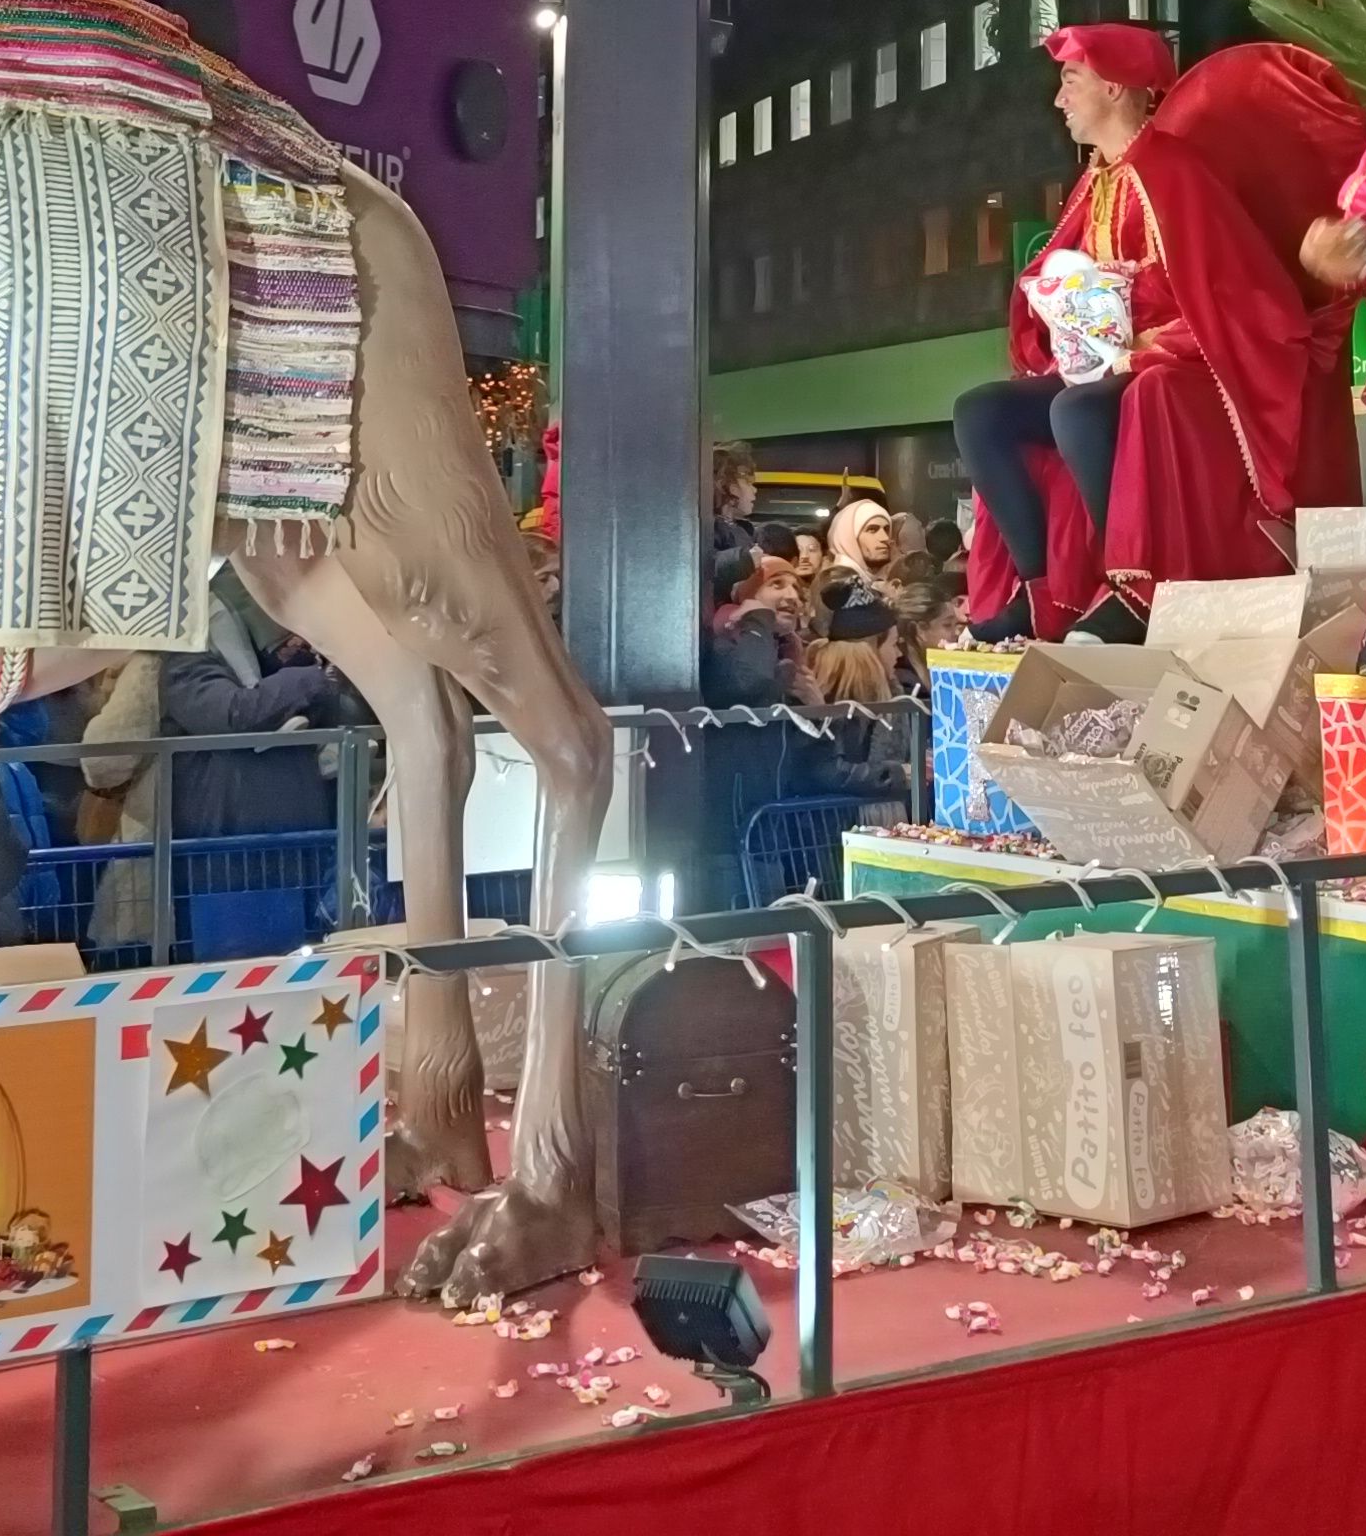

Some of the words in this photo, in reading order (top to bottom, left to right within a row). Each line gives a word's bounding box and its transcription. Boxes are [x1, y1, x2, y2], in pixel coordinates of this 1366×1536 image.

[1067, 974, 1098, 1041] feo
[1070, 1060, 1099, 1192] Patito
[1133, 1091, 1147, 1157] Patito
[1026, 1133, 1047, 1181] Gluten
[1134, 1167, 1149, 1201] feo
[1037, 1175, 1053, 1201] Sin
